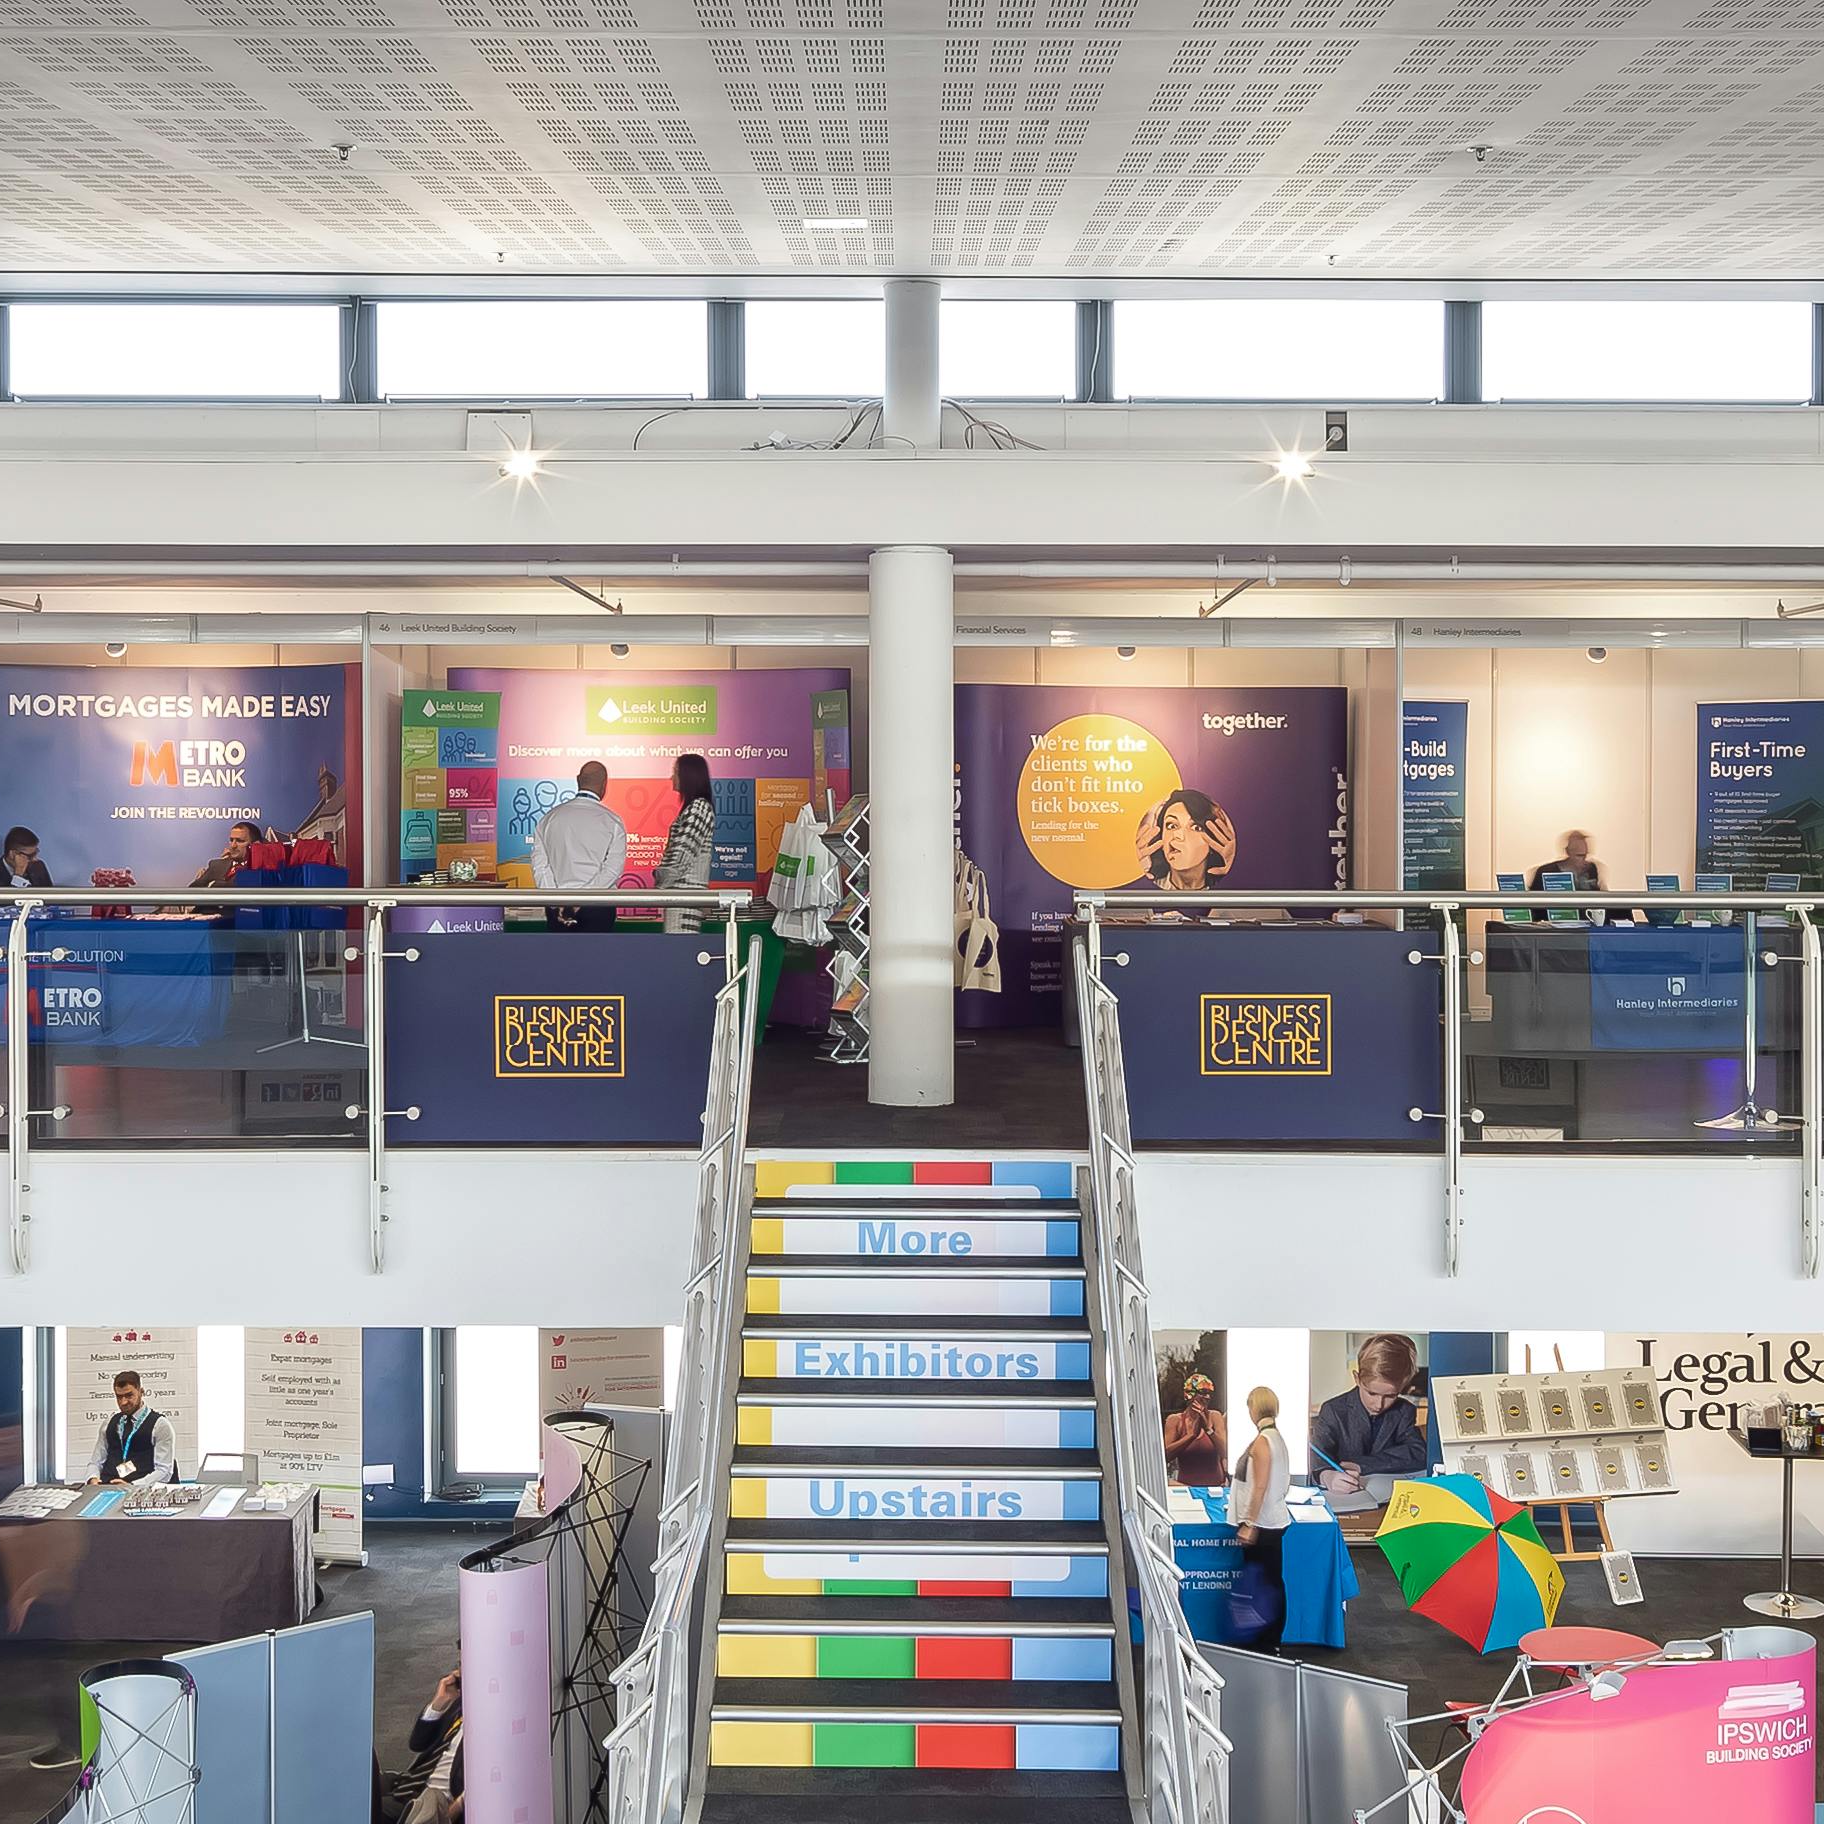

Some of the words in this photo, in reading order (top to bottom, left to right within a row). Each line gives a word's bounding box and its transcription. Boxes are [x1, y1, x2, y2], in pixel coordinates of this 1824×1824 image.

[956, 626, 991, 634] Financial
[993, 626, 1026, 634] Services
[9, 694, 194, 718] MORTGAGES
[202, 695, 275, 718] MADE
[281, 694, 330, 718] EASY
[623, 700, 656, 715] Leek
[660, 700, 707, 715] United
[1031, 735, 1079, 751] We're
[1085, 735, 1111, 751] for
[1117, 735, 1146, 751] the
[1711, 742, 1806, 758] First-Time
[1031, 756, 1087, 772] clients
[1094, 757, 1132, 772] who
[1711, 762, 1773, 780] Buyers
[183, 769, 246, 787] BANK
[1031, 777, 1076, 793] don't
[1081, 776, 1100, 793] fit
[1107, 776, 1143, 793] into
[449, 789, 468, 798] 95%
[111, 807, 145, 819] JOIN
[149, 807, 176, 819] THE
[179, 807, 261, 819] REVOLUTION
[1031, 797, 1061, 813] tick
[1068, 797, 1124, 813] boxes.
[1031, 822, 1066, 832] Lending
[1068, 822, 1081, 830] for
[1084, 822, 1099, 830] the
[1617, 999, 1655, 1009] Hanley
[1658, 999, 1737, 1007] Intermediaries
[46, 1012, 101, 1026] BANK
[858, 1222, 972, 1254] More
[90, 1353, 120, 1361] Manual
[122, 1352, 175, 1361] underwriting
[271, 1354, 291, 1363] Expat
[294, 1355, 332, 1364] mortgages
[795, 1342, 1040, 1379] Exhibitors
[284, 1431, 319, 1440] Proprietor
[809, 1480, 1023, 1520] Upstairs
[1192, 1581, 1232, 1590] LENDING
[1717, 1715, 1807, 1746] IPSWICH
[1706, 1748, 1769, 1764] BUILDING
[1772, 1735, 1812, 1761] SOCIETY
